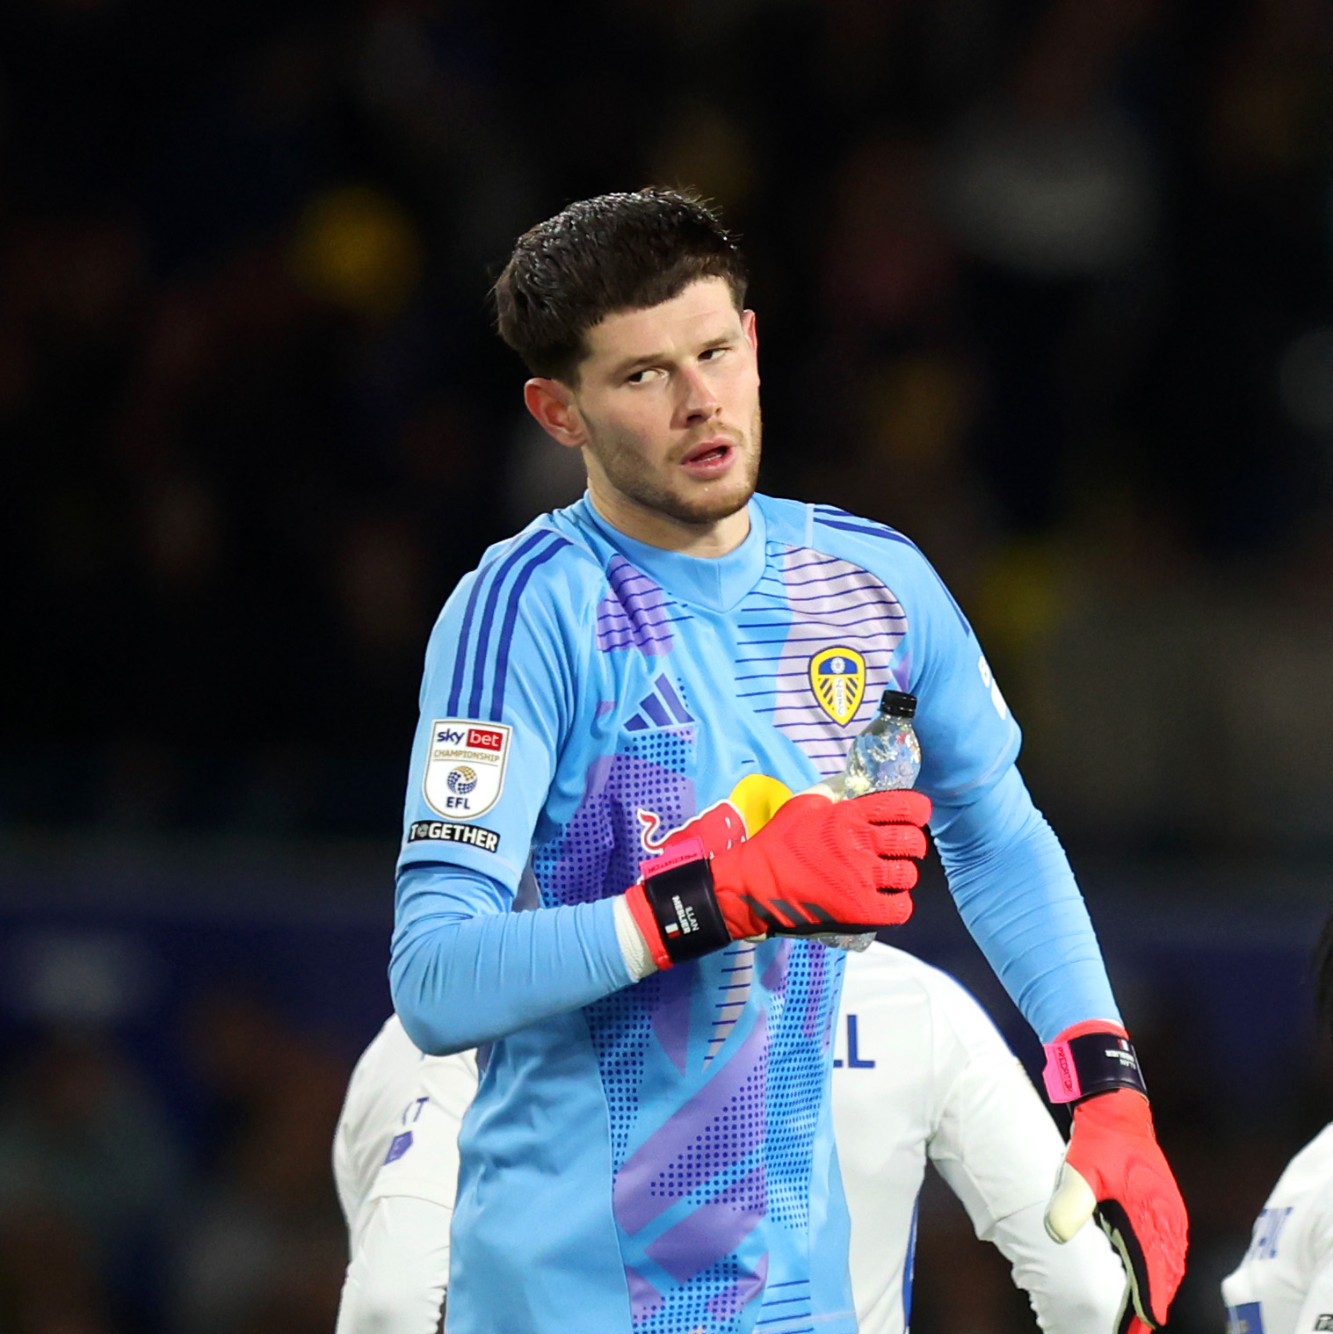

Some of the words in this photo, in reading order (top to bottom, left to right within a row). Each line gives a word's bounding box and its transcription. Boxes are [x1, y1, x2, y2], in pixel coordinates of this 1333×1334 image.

[436, 728, 465, 745] sky
[469, 731, 500, 747] bet
[434, 749, 500, 763] CHAMPIONSHIP
[446, 796, 471, 810] EFL
